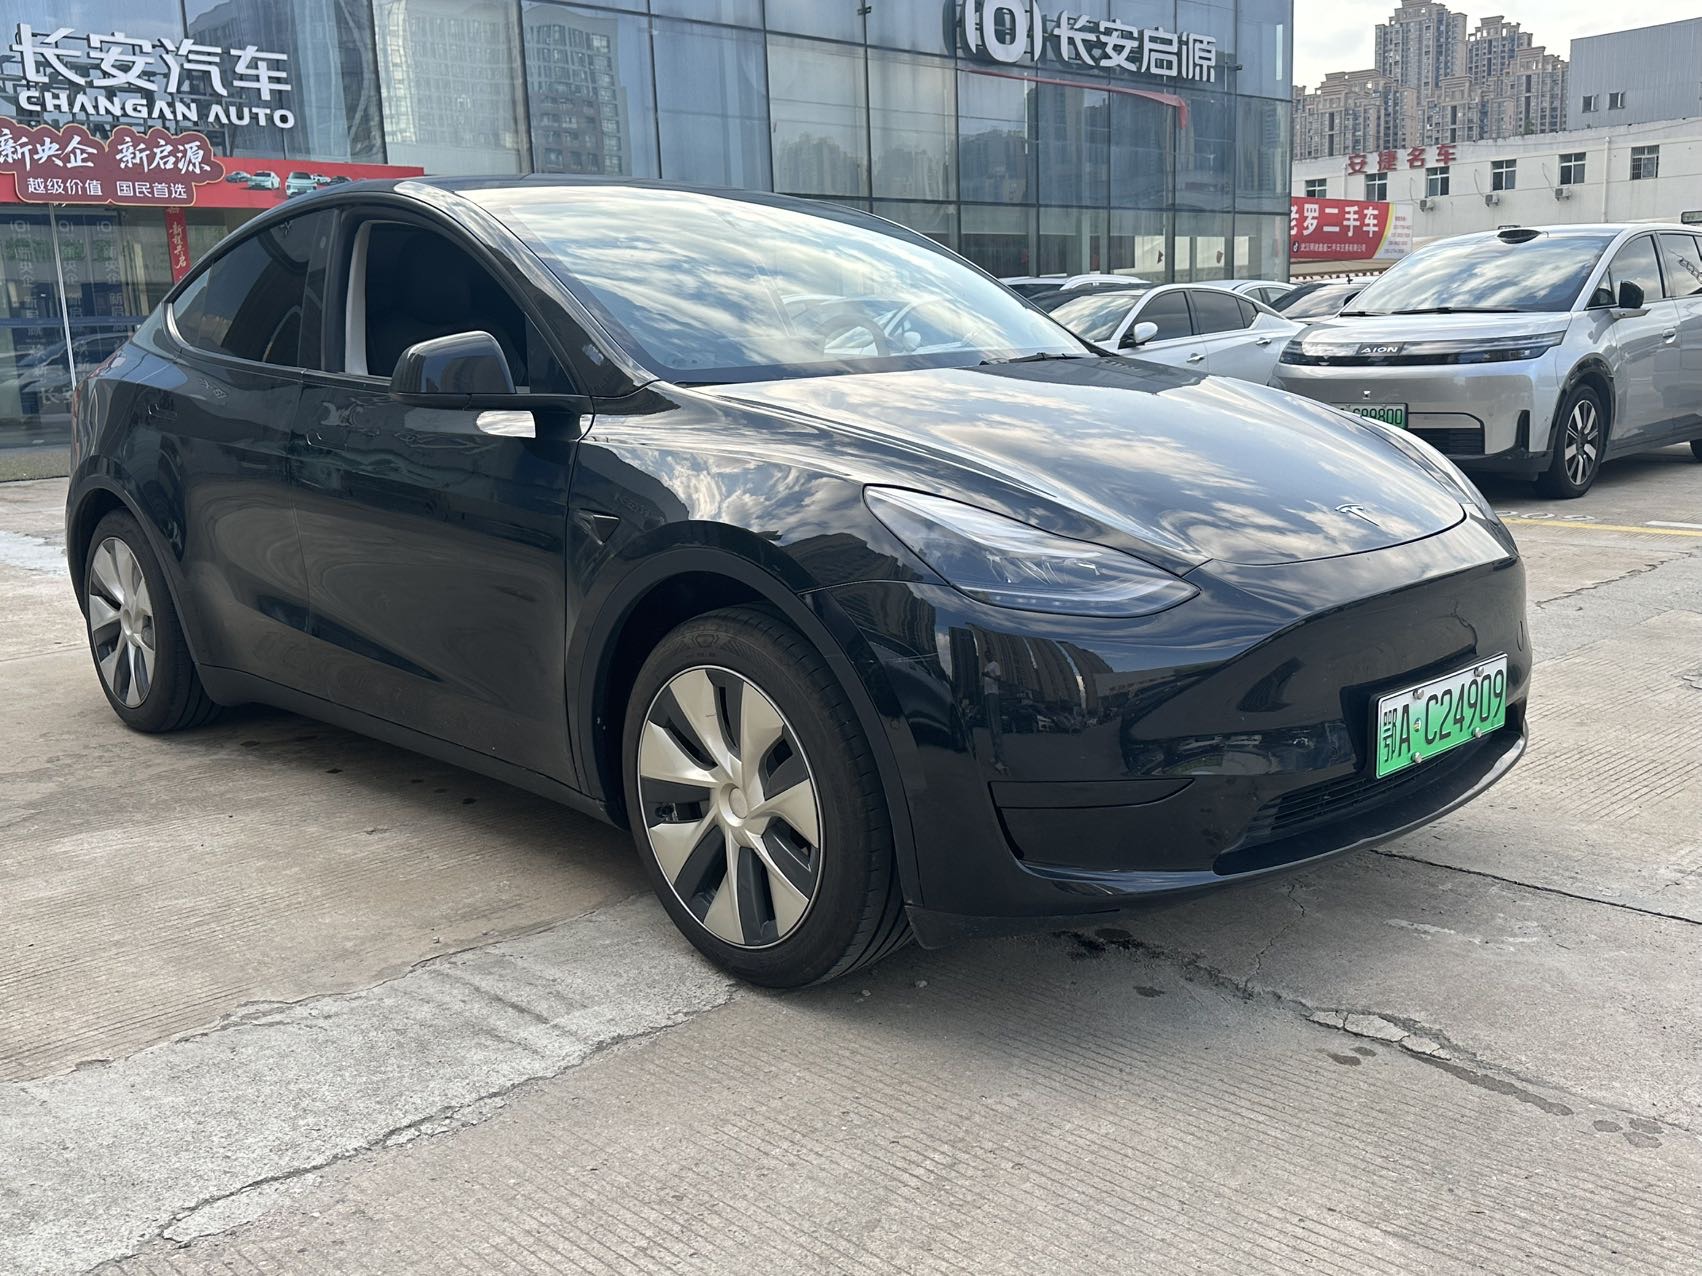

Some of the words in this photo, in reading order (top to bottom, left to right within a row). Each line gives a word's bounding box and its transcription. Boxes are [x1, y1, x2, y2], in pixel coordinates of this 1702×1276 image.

[10, 22, 292, 100] 长安汽车
[1053, 9, 1217, 83] 长安启源
[19, 90, 199, 122] CHANGAN
[207, 104, 296, 129] AUTO
[0, 128, 98, 172] 新央企
[115, 136, 211, 175] 新启源
[1347, 143, 1457, 177] 安捷名车
[27, 177, 103, 196] 越级价值
[116, 180, 188, 199] 国民首选
